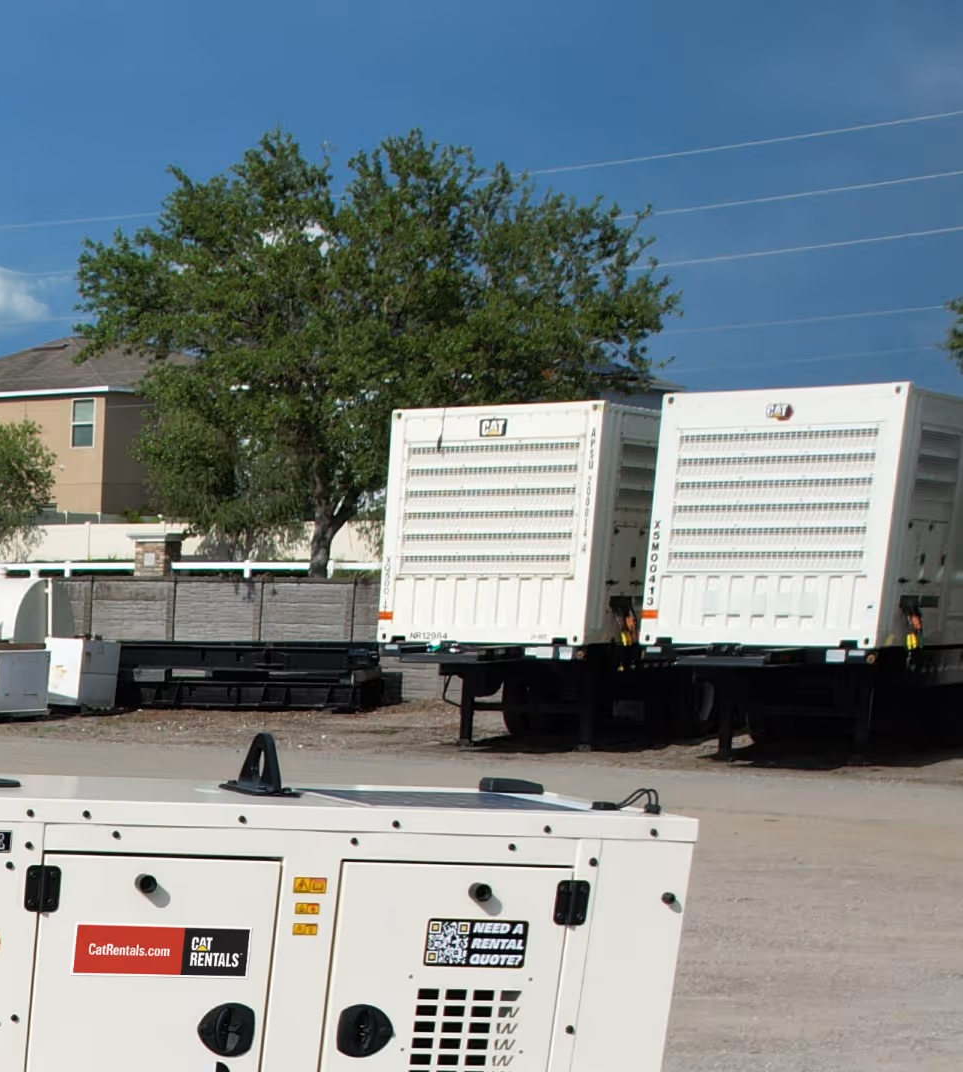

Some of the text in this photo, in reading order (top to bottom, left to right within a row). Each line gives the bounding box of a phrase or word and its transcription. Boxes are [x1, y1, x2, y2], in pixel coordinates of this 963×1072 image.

[766, 404, 789, 418] CAT
[482, 420, 505, 435] CAT
[646, 520, 661, 606] X5M00413
[472, 922, 525, 935] NEED A
[88, 943, 171, 957] CatRentals.com
[191, 936, 213, 951] CAT
[470, 938, 525, 950] RENTAL
[189, 952, 240, 968] RENTALS
[469, 954, 524, 966] QUOTE?
